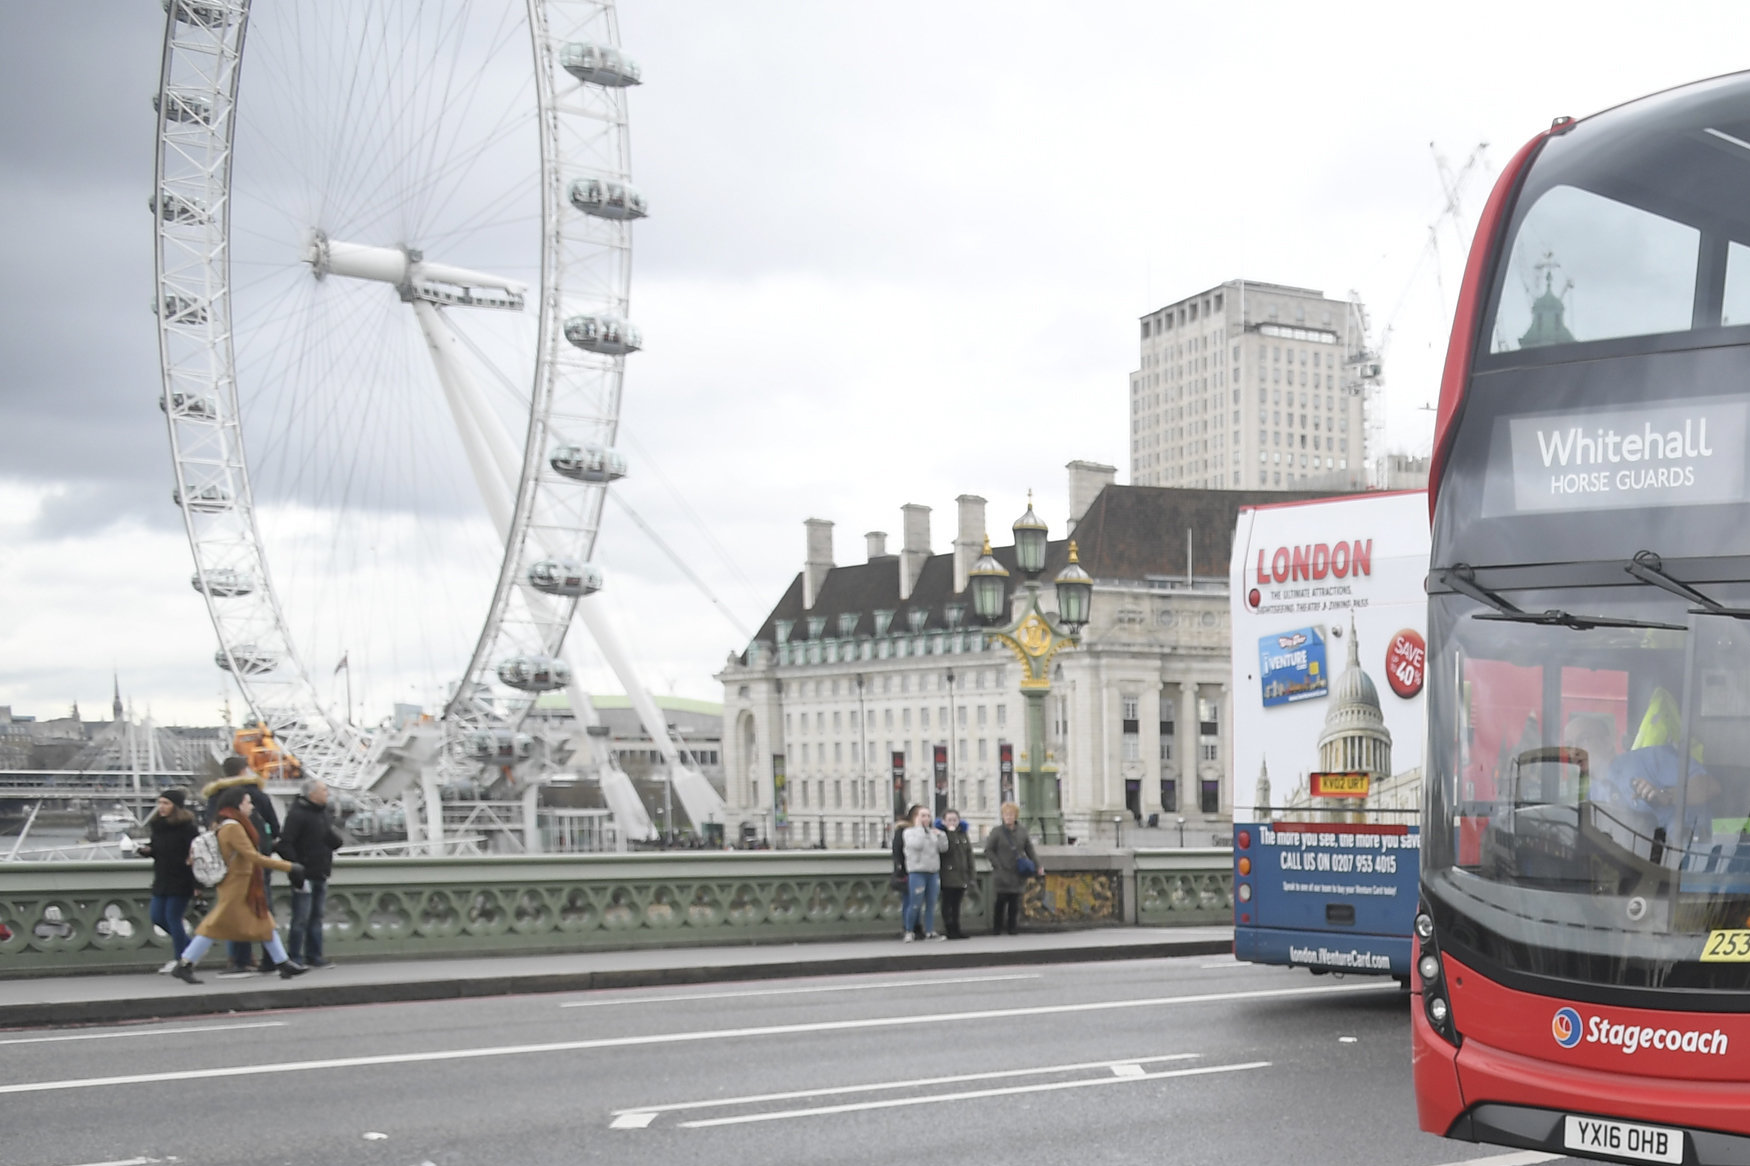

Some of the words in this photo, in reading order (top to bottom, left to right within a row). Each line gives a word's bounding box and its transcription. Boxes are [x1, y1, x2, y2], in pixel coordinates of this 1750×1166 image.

[1537, 417, 1713, 468] Whitehall
[1551, 472, 1610, 495] HORSE
[1616, 466, 1695, 491] GUARDS
[1256, 539, 1373, 584] LONDON
[1393, 636, 1425, 668] SAVE
[1259, 825, 1275, 845] The
[1277, 831, 1300, 846] more
[1301, 832, 1317, 851] you
[1319, 833, 1338, 848] see,
[1355, 834, 1380, 849] more
[1381, 835, 1399, 853] you
[1280, 851, 1302, 871] CALL
[1303, 853, 1316, 872] US
[1317, 853, 1330, 872] ON
[1332, 854, 1353, 873] 0207
[1355, 855, 1373, 873] 953
[1374, 856, 1397, 874] 4015
[1586, 1015, 1728, 1055] Stagecoach
[1578, 1121, 1622, 1149] YX16
[1627, 1128, 1669, 1155] OHB
